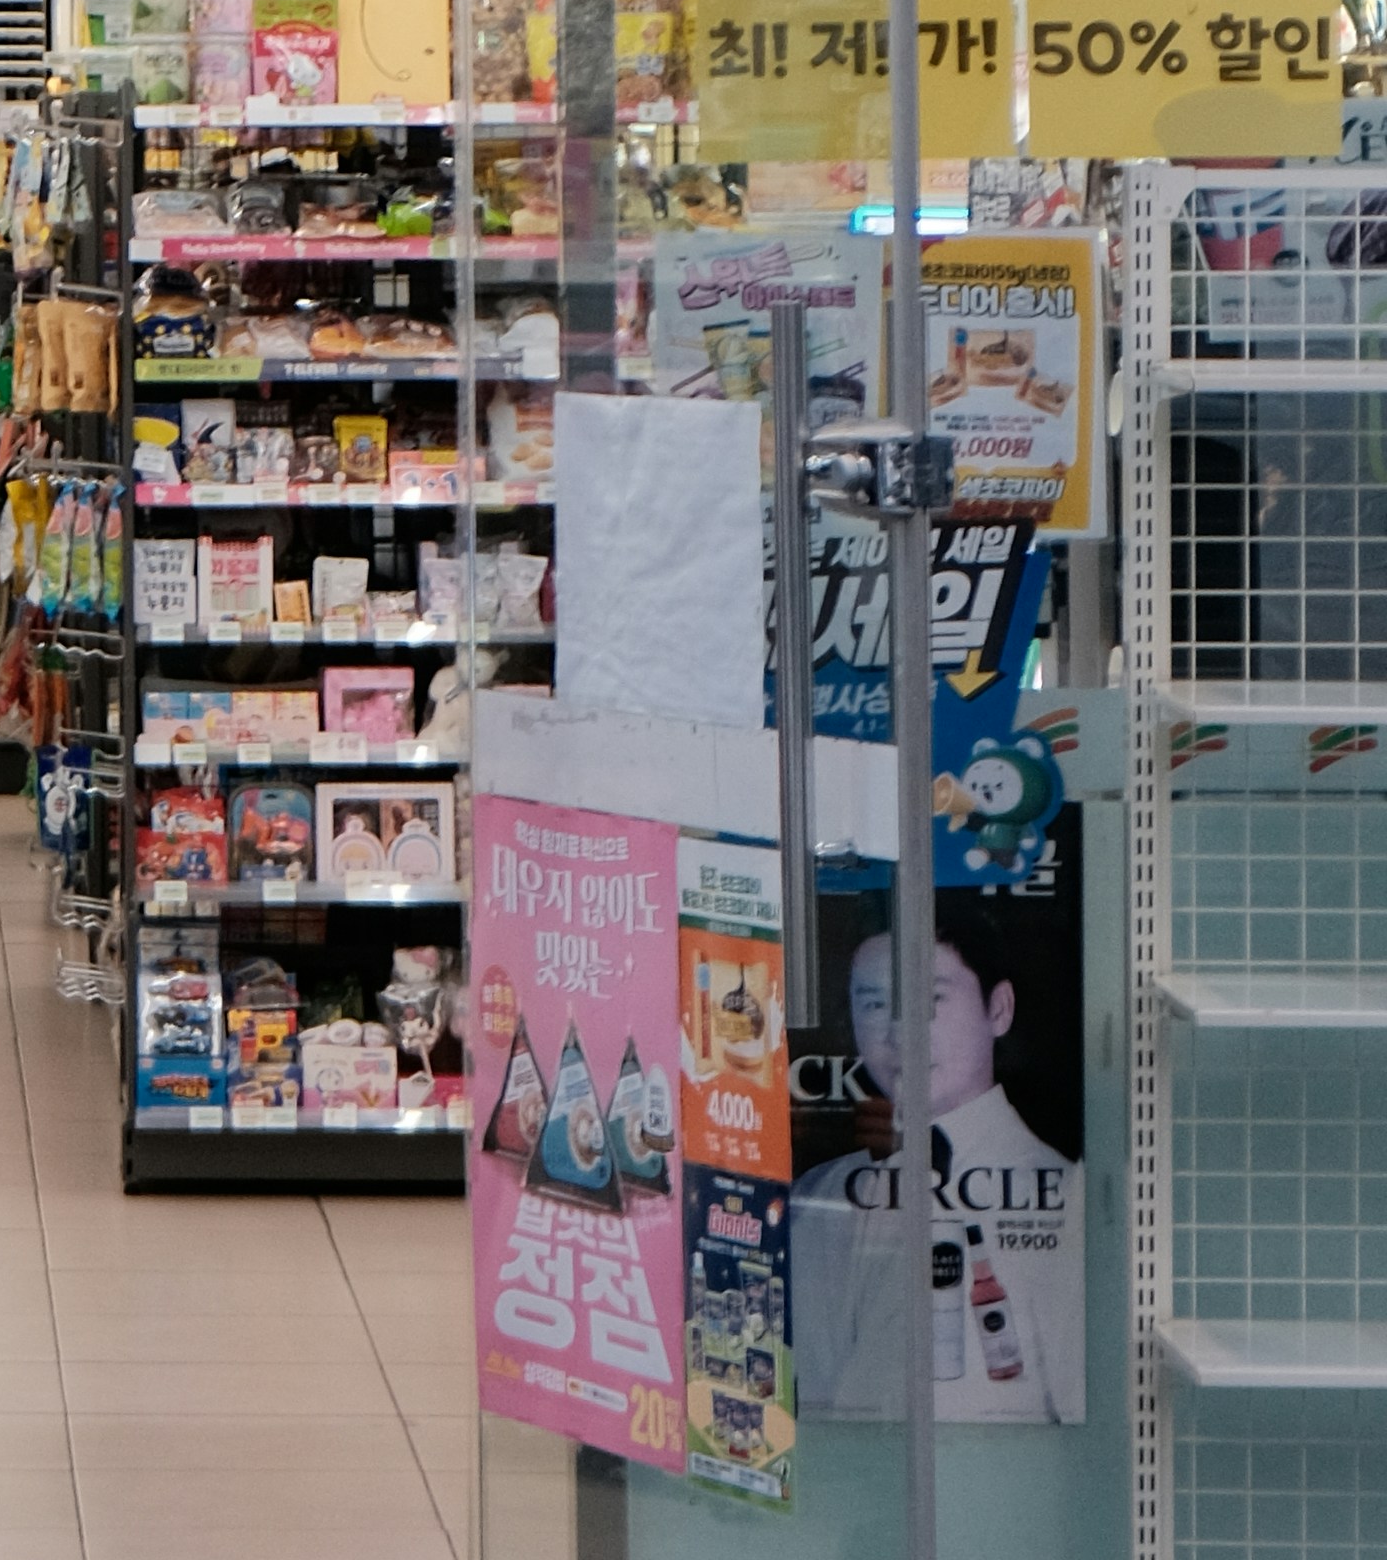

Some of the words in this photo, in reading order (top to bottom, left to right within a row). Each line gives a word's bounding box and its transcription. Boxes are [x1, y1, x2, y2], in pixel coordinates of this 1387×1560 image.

[707, 20, 789, 78] 최!
[810, 19, 890, 76] 저!
[916, 17, 999, 77] 가!
[1031, 18, 1189, 77] 50%
[1206, 12, 1331, 82] 할인
[951, 436, 1034, 460] ,000원
[941, 524, 1017, 563] 세일
[491, 842, 574, 924] 데우지
[579, 871, 665, 936] 않아도
[534, 930, 615, 1000] 맛있는
[843, 1165, 1066, 1212] CIRCLE
[493, 1233, 674, 1385] 정점
